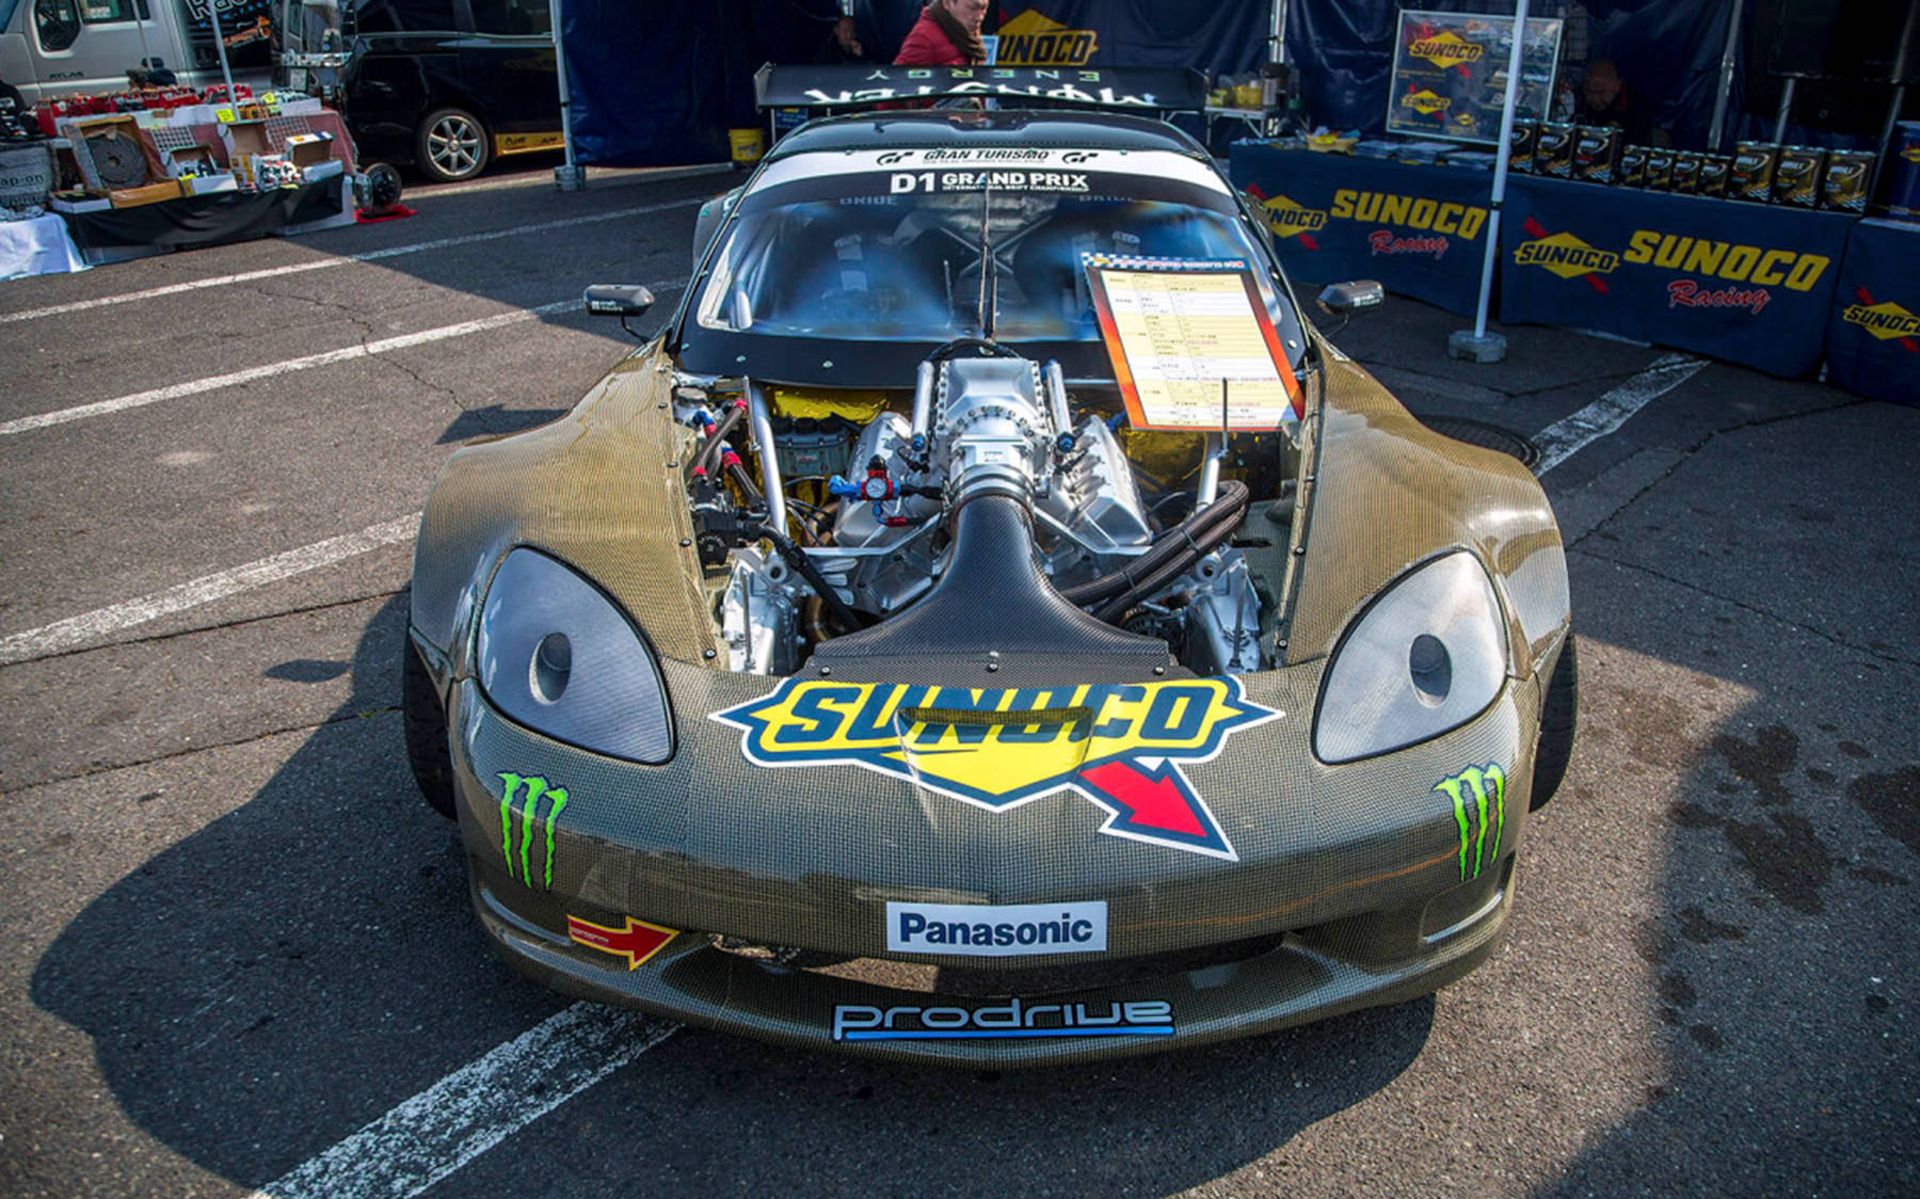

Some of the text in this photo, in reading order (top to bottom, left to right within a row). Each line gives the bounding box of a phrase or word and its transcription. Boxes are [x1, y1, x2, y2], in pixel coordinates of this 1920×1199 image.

[997, 33, 1093, 62] UNOCO
[1412, 42, 1480, 60] SUNOCO
[50, 71, 85, 79] ATLAS
[866, 69, 1100, 82] ENERGY
[923, 150, 1050, 160] GRAN TURISMO
[890, 173, 936, 194] D1
[942, 173, 1089, 188] GRAND PRIX
[1267, 208, 1324, 227] NOCO
[1330, 189, 1487, 240] SUNOCO
[1369, 230, 1449, 260] Racing
[1518, 244, 1616, 272] SUNOCO
[1623, 229, 1830, 292] SUNOCO
[1667, 279, 1771, 315] Racing
[1847, 306, 1920, 333] SUNOC
[774, 684, 1206, 744] SUNOCO
[900, 912, 1093, 946] Panasonic
[834, 998, 1174, 1041] prodrive
